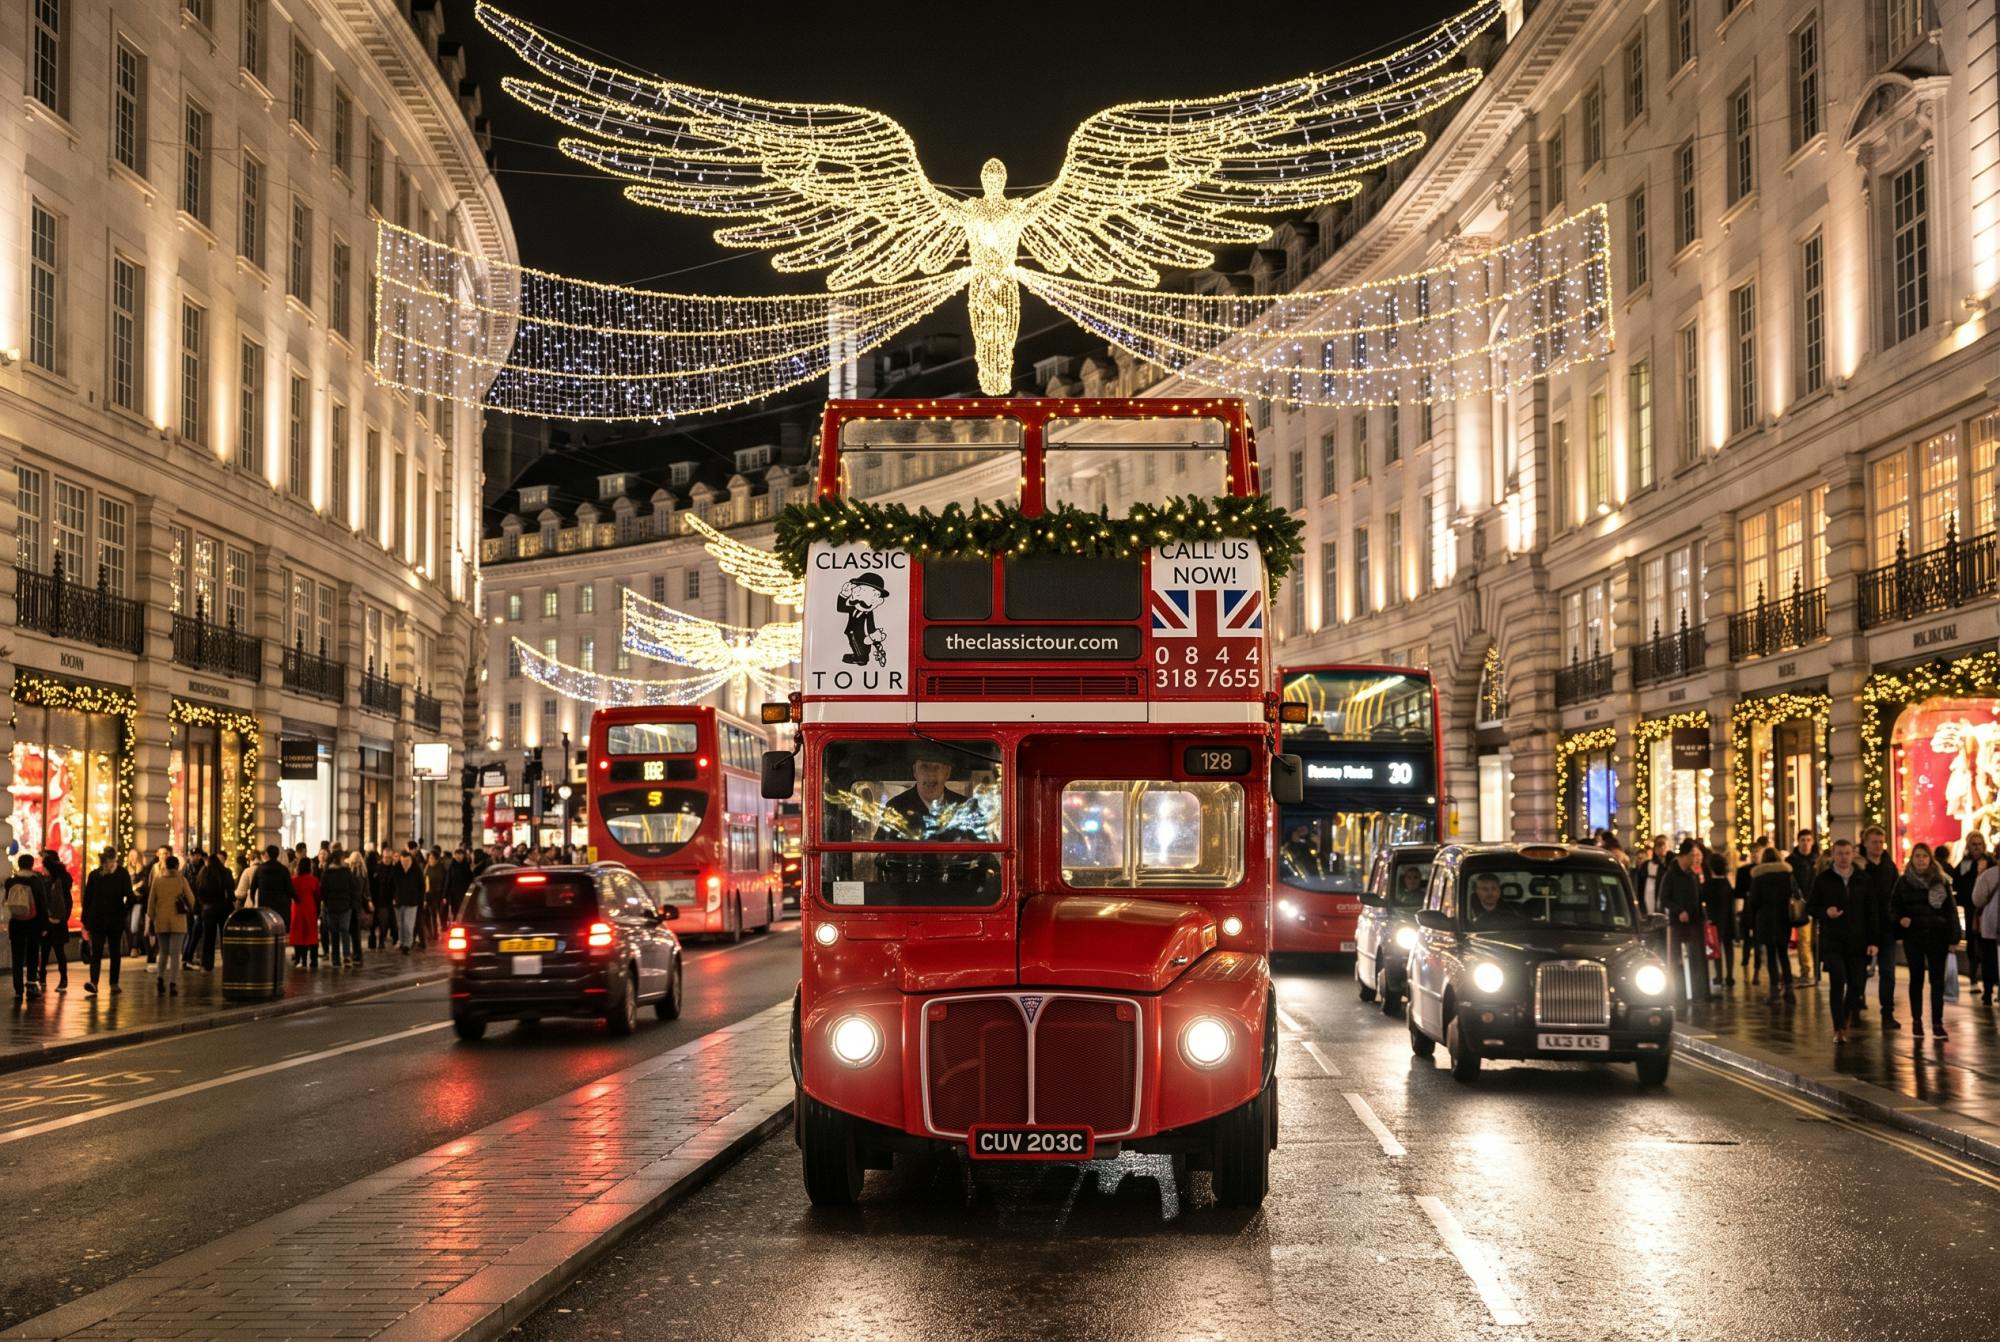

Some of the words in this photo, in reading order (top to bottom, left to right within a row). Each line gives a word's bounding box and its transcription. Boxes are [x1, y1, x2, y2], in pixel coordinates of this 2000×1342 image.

[815, 551, 906, 570] CLASSIC
[1160, 542, 1215, 560] CALL
[1222, 542, 1249, 560] US
[1173, 566, 1237, 585] NOW!
[945, 633, 1118, 650] theclassictour.com
[812, 670, 904, 690] TOUR
[1155, 668, 1198, 688] 318
[1205, 668, 1260, 688] 7655
[1200, 752, 1233, 770] 128
[980, 1133, 1022, 1151] CUV
[1027, 1133, 1083, 1152] 203C
